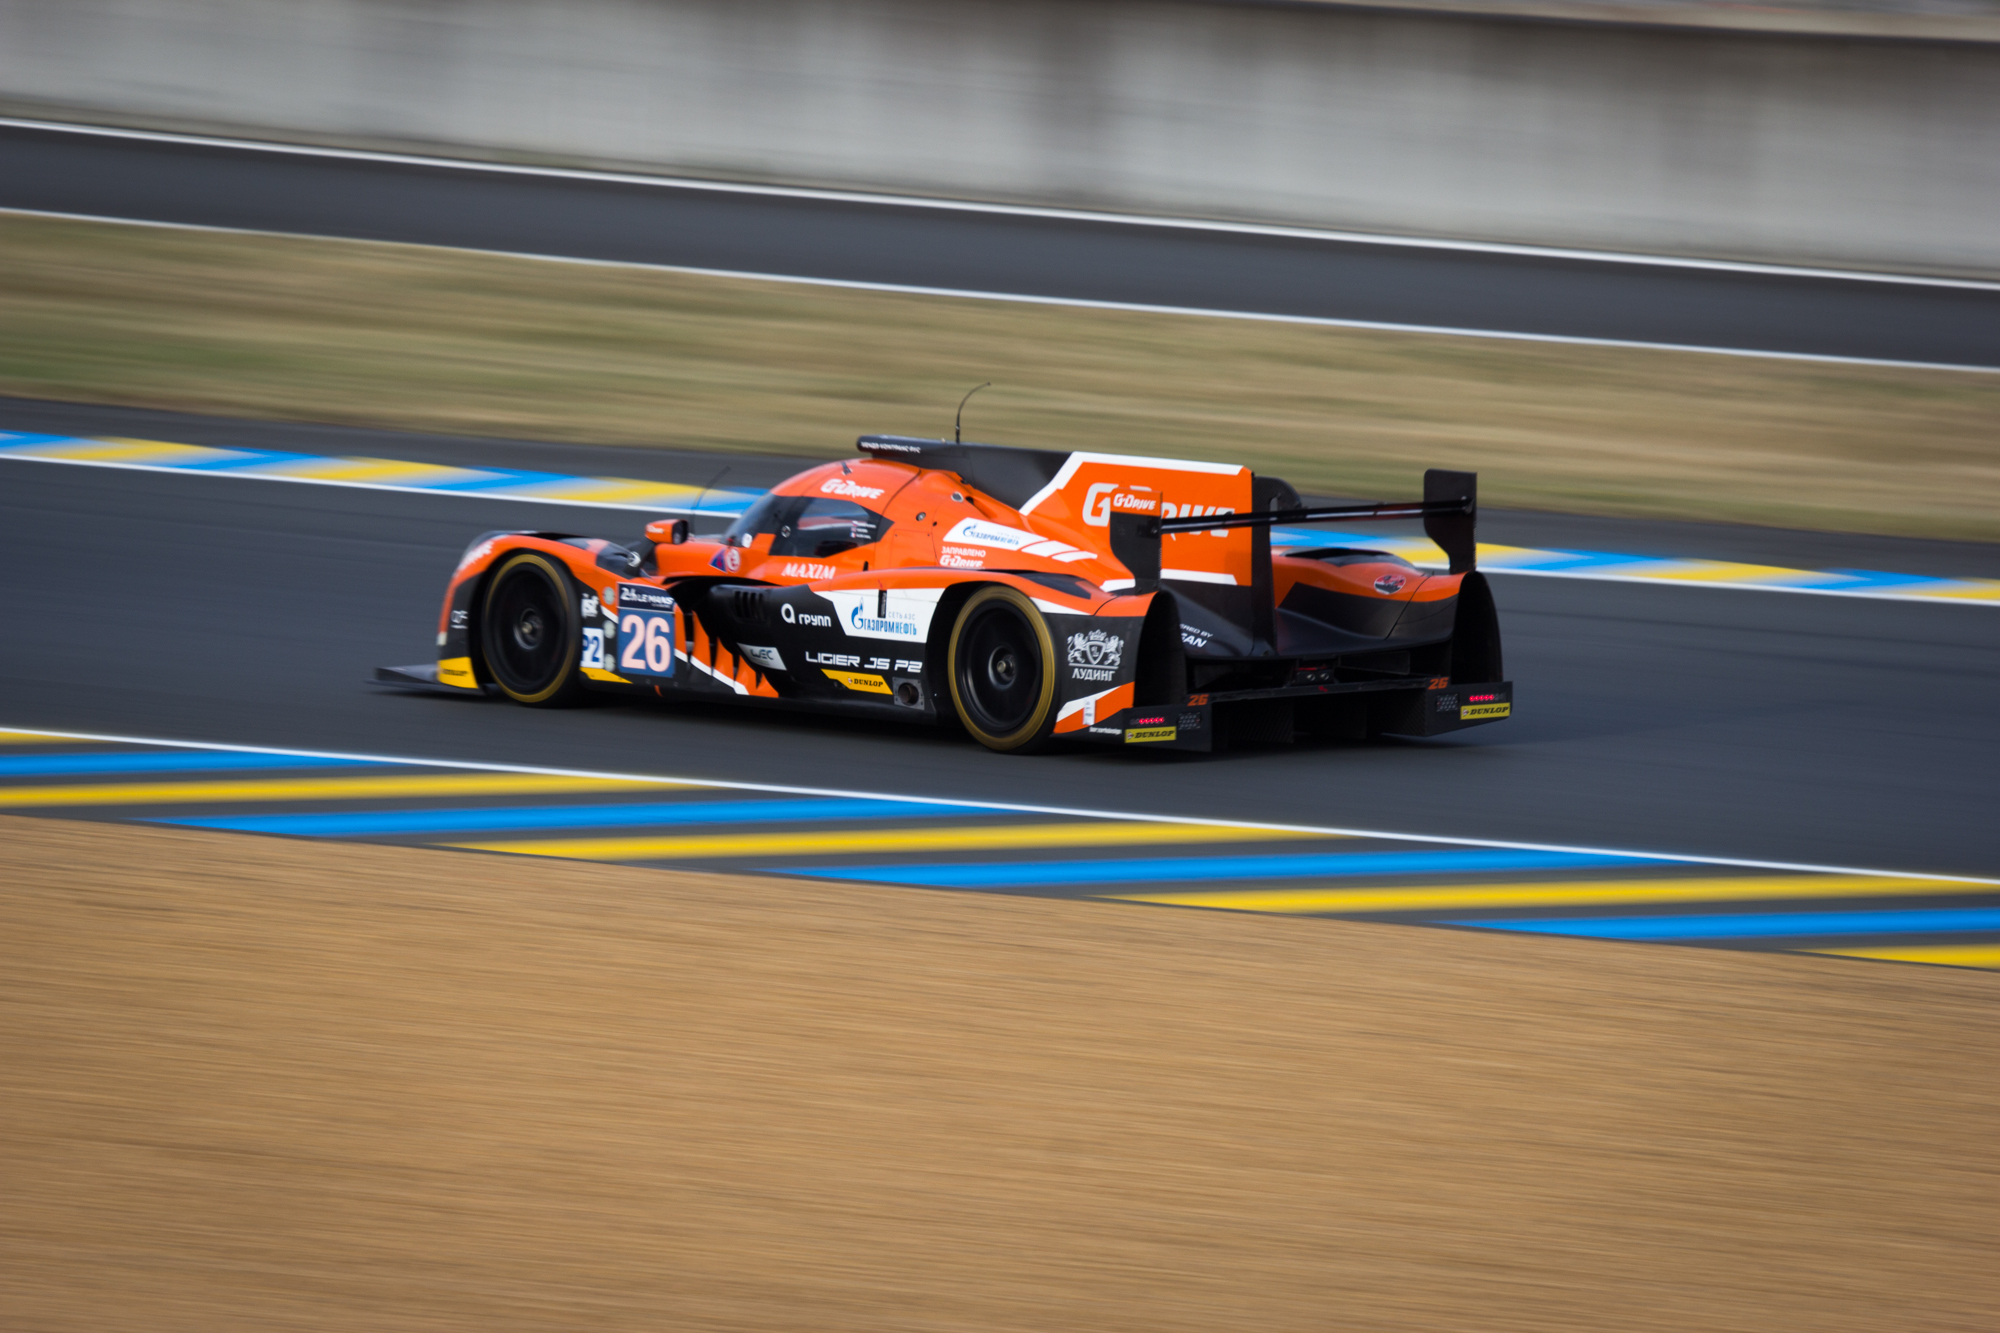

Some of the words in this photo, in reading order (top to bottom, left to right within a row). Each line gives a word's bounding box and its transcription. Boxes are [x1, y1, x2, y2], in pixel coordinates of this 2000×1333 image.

[941, 546, 986, 558] ЗАПРАВЛЕНО
[781, 562, 836, 580] MAXIM
[1200, 630, 1213, 638] BY
[621, 614, 671, 672] 26
[750, 649, 774, 661] WEC
[805, 651, 860, 668] LIGIER
[864, 657, 891, 670] JS
[894, 659, 923, 673] P2
[1072, 667, 1116, 682] ЛУДИНГ
[853, 678, 884, 688] DUNLOP
[1428, 677, 1449, 690] 26
[1187, 694, 1210, 707] 26
[1470, 706, 1509, 716] DUNLOP
[1134, 730, 1175, 739] DUNLOP
